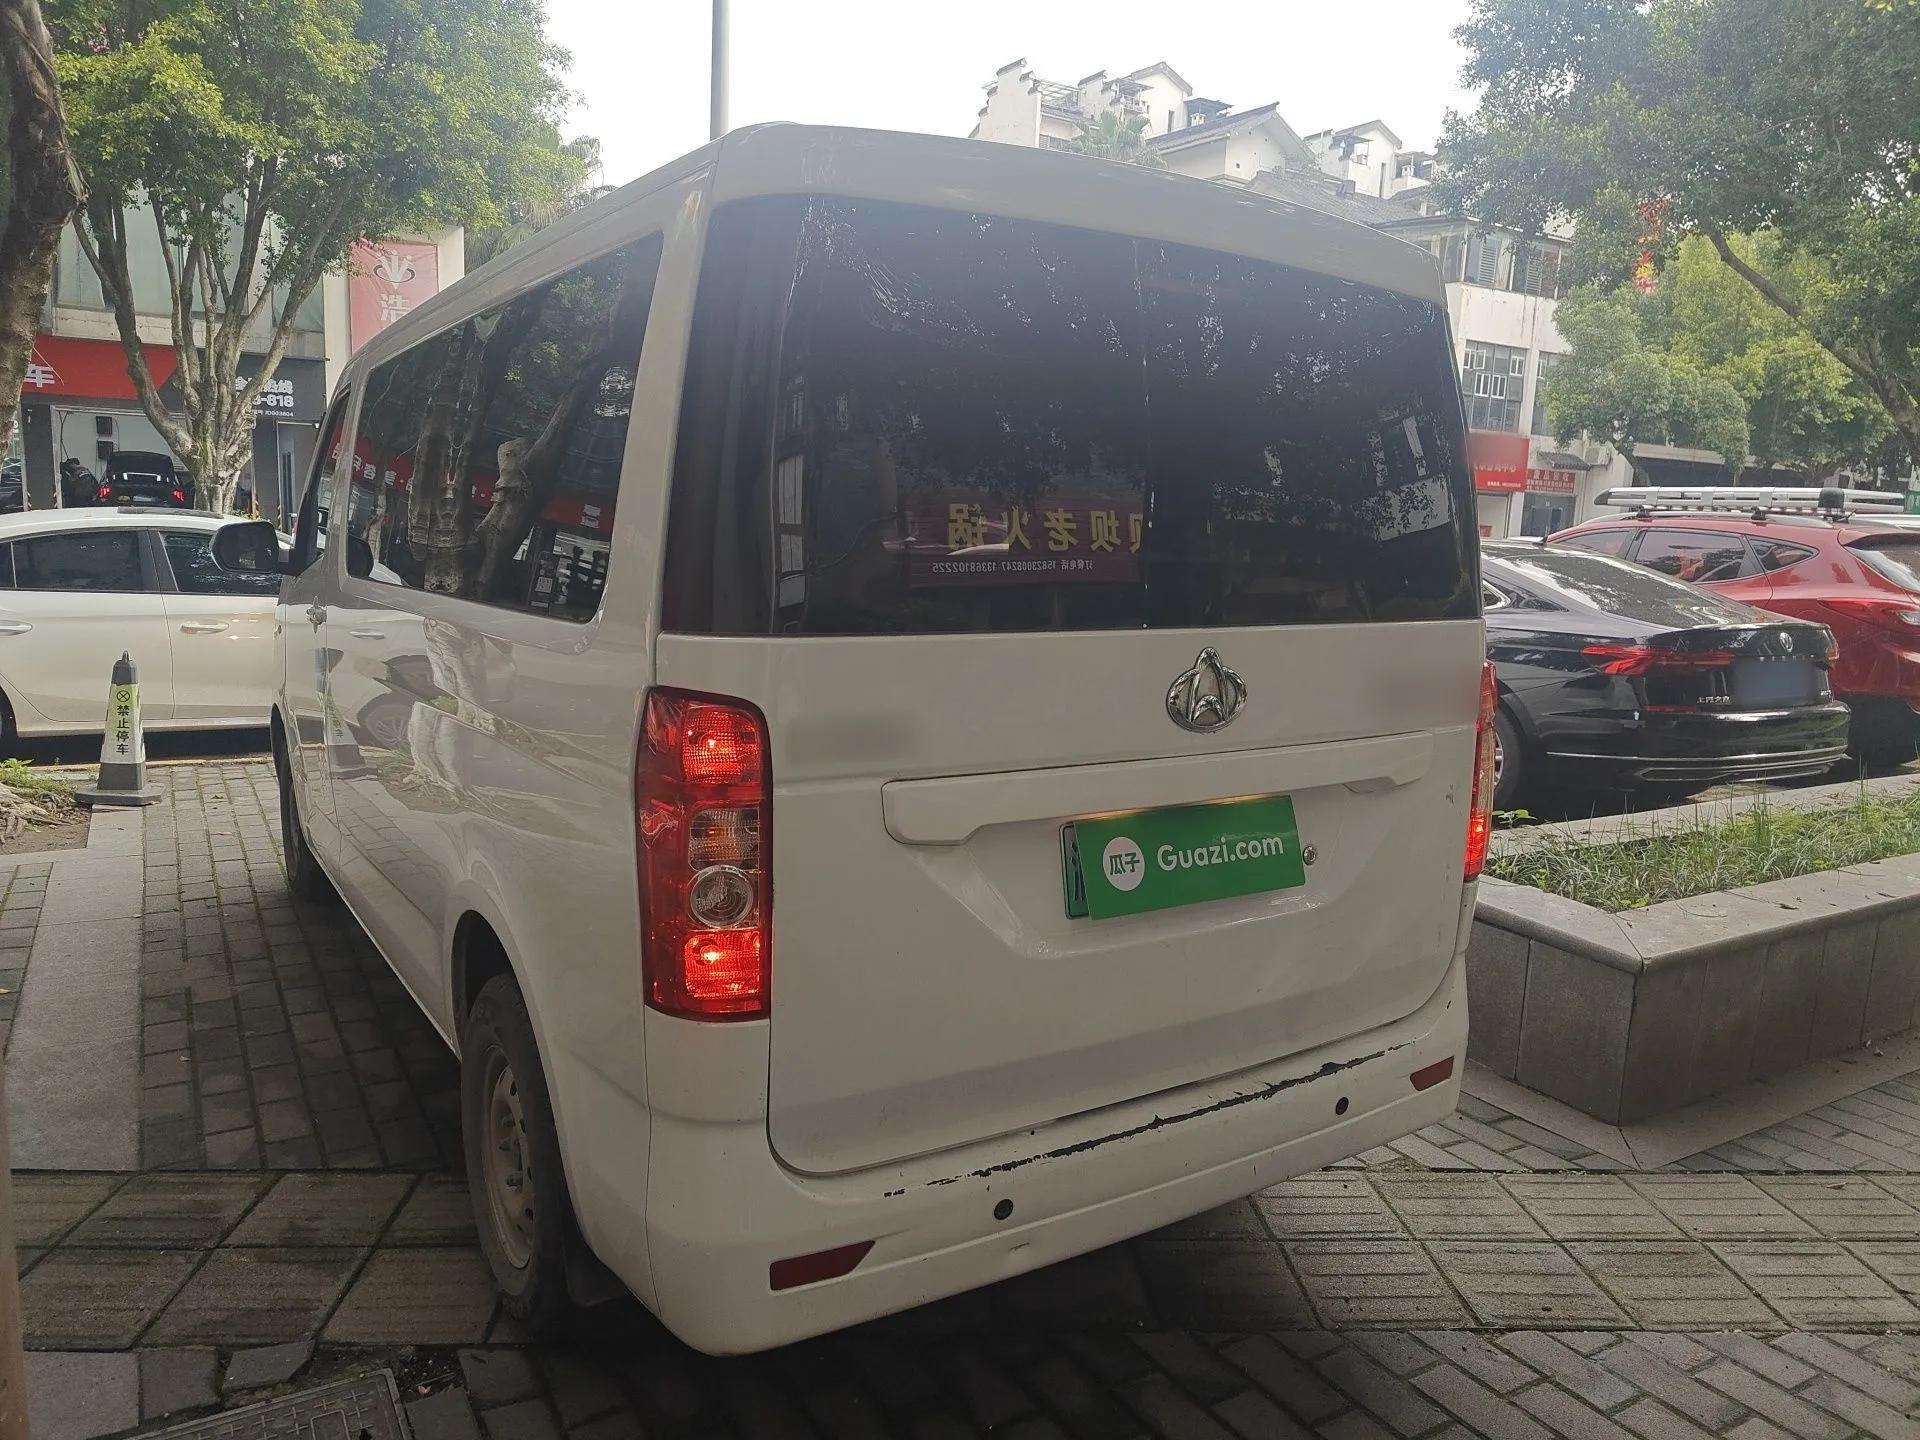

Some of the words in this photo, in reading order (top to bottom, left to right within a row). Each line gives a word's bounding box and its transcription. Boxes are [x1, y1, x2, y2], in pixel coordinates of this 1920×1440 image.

[115, 704, 130, 755] 禁止停车
[1108, 852, 1141, 876] 瓜子
[1156, 835, 1284, 871] Guazi.com
